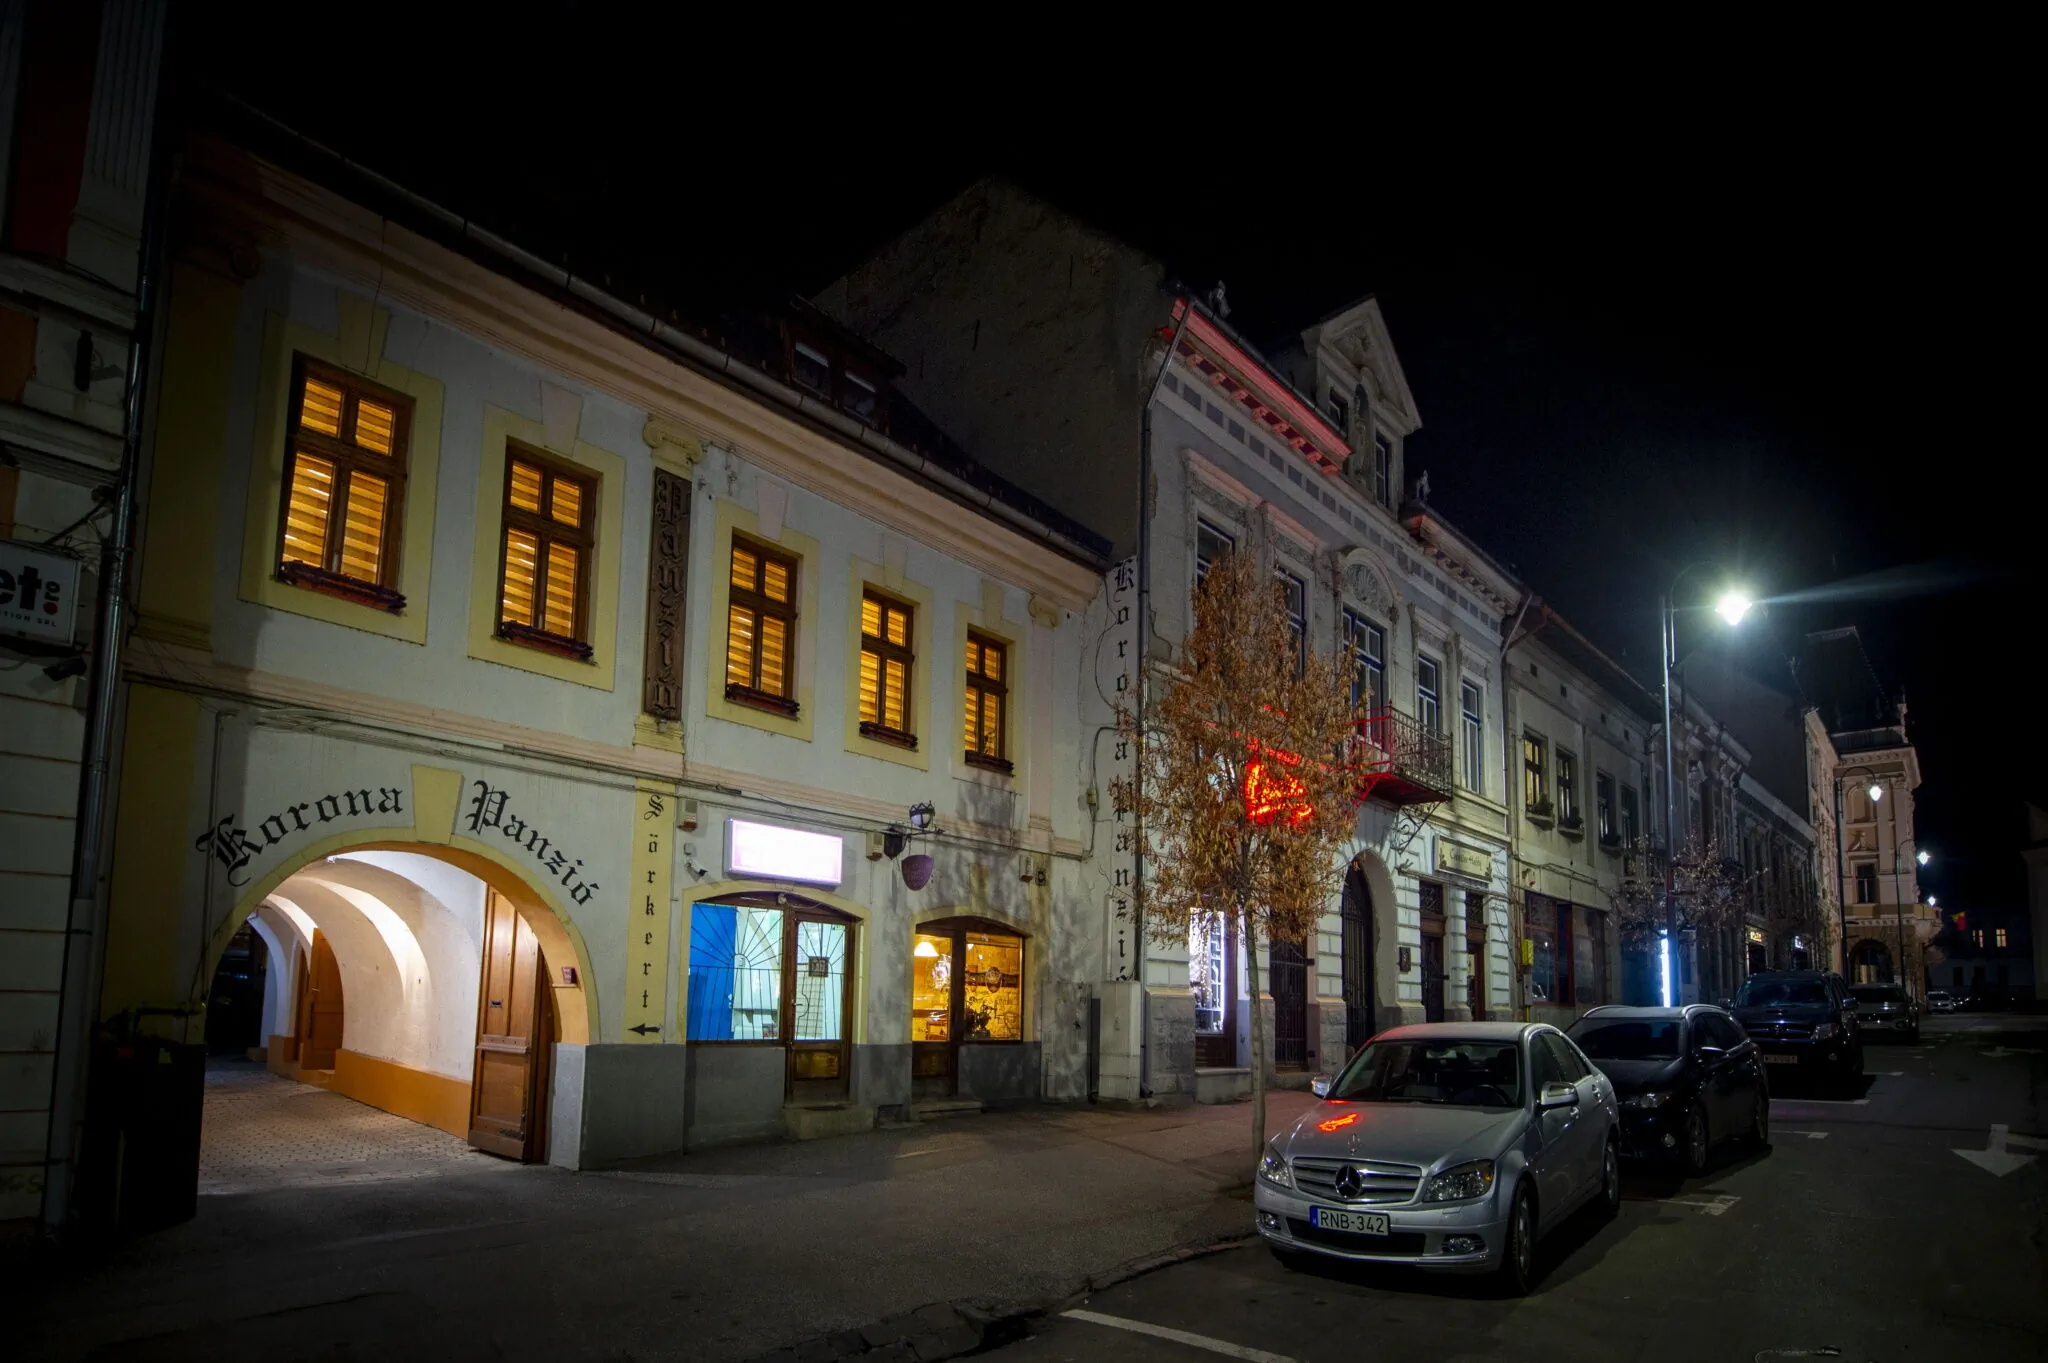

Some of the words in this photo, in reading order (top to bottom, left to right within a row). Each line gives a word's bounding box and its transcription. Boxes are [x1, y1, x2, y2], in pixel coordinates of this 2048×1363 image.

[0, 610, 30, 621] TION
[196, 786, 403, 887] Korona
[465, 780, 600, 906] Panzió
[641, 794, 665, 1009] Sörkert
[1320, 1211, 1384, 1233] RNB-342
